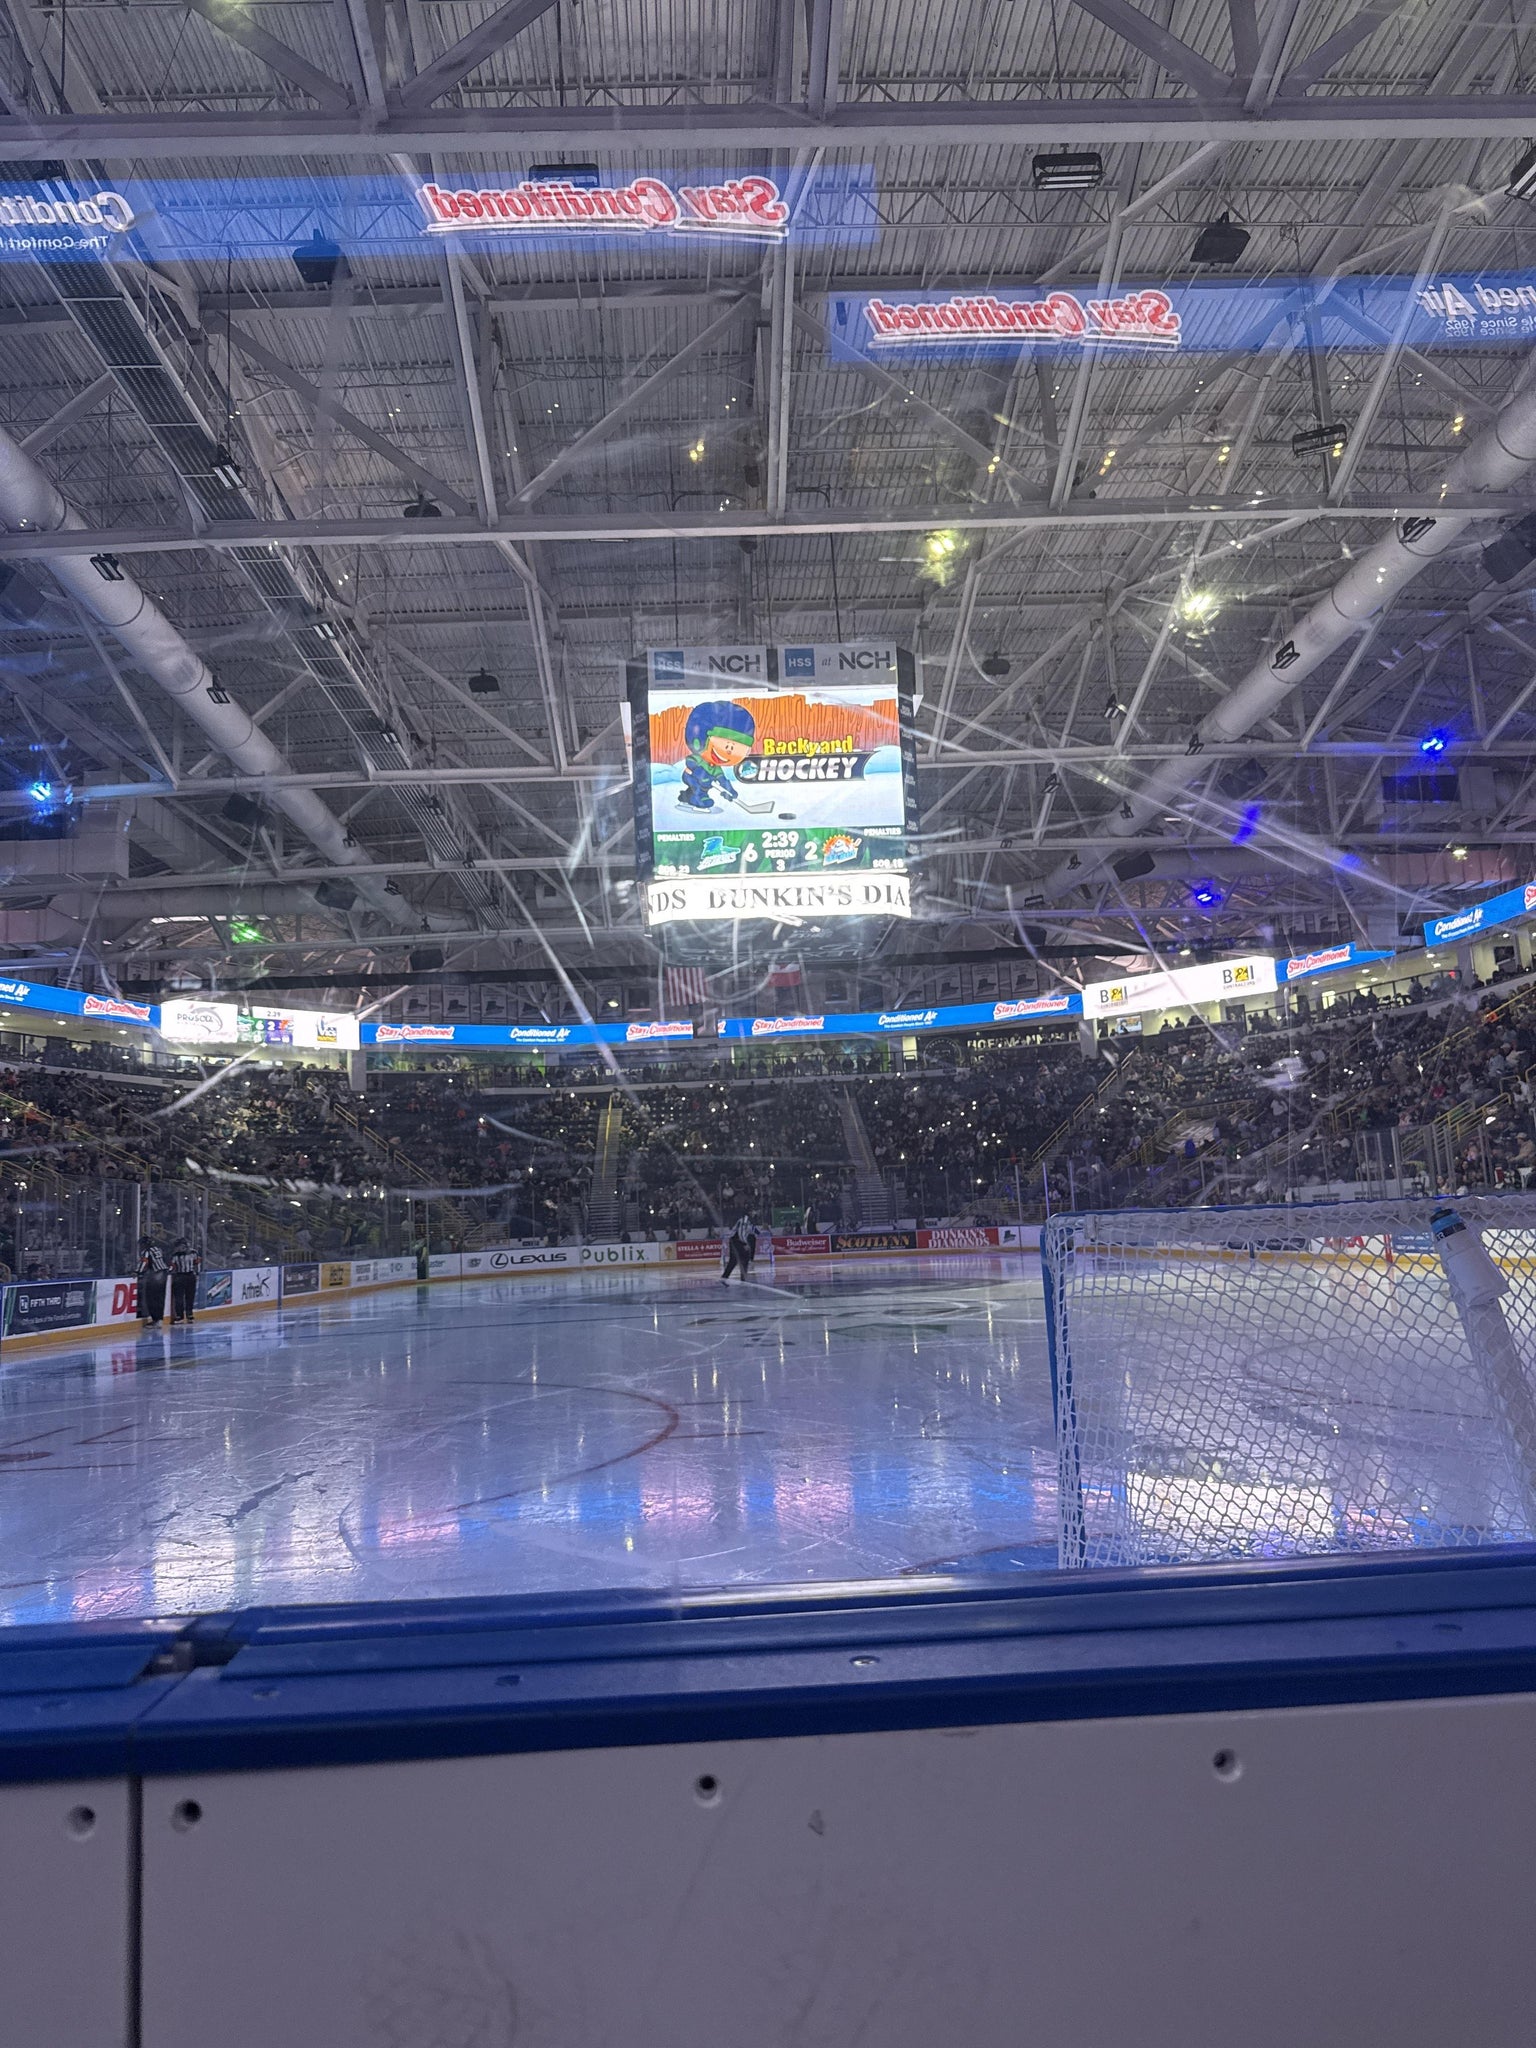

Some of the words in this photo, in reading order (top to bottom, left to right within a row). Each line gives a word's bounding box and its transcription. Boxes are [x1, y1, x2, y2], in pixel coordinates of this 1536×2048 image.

[658, 659, 681, 672] HSS
[708, 654, 761, 673] NCH
[788, 657, 812, 668] HSS
[838, 651, 891, 670] NCH
[763, 736, 853, 758] Backyard
[758, 757, 858, 781] HOCKEY
[657, 834, 696, 842] PENALTIES
[762, 830, 799, 849] 2:39
[864, 828, 902, 836] PENALTIES
[744, 843, 758, 862] 6
[765, 849, 796, 858] PERIOD
[804, 842, 818, 860] 2
[776, 861, 786, 872] 3
[709, 884, 852, 910] DUNKIN'S
[1434, 914, 1473, 936] Conditioned
[1288, 958, 1306, 978] Stay
[1306, 946, 1350, 970] Conditioned
[84, 996, 104, 1014] Stay
[104, 1000, 150, 1020] Conditioned
[994, 1002, 1016, 1020] Stay
[1016, 997, 1069, 1012] Conditioned
[255, 1021, 264, 1030] 6
[268, 1021, 276, 1031] 2
[752, 1017, 775, 1034] Stay
[774, 1016, 824, 1030] Conditioned
[878, 1013, 924, 1026] Conditioned
[924, 1011, 938, 1022] Air
[376, 1026, 400, 1041] Stay
[400, 1025, 454, 1040] Conditioned
[510, 1028, 556, 1038] Conditioned
[556, 1027, 571, 1038] Air
[627, 1023, 650, 1040] Stay
[786, 1238, 827, 1246] Budweiser
[836, 1235, 910, 1248] SCOTLYNN
[932, 1227, 986, 1240] DUNKIN'S
[928, 1238, 990, 1248] DIAMONDS
[511, 1253, 567, 1264] LEXUS
[581, 1246, 645, 1264] Publix
[30, 1298, 45, 1308] FIFTH
[46, 1296, 61, 1306] THIRD
